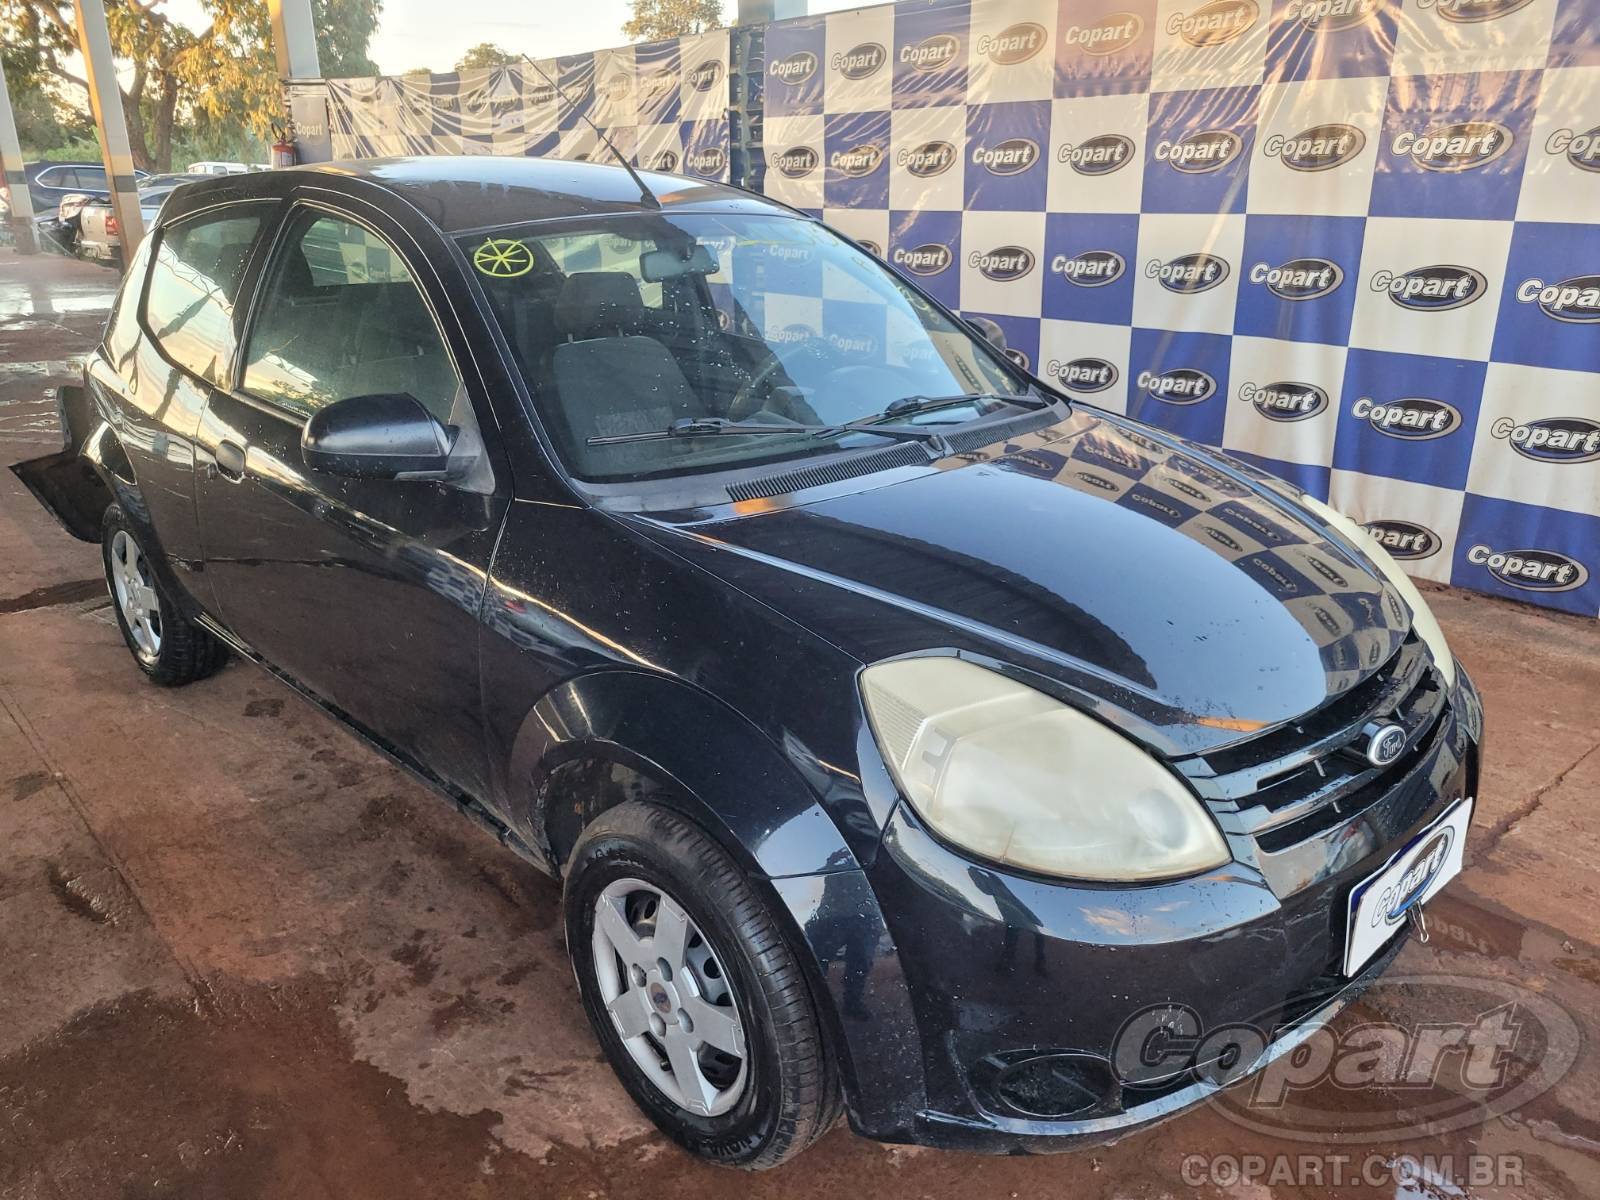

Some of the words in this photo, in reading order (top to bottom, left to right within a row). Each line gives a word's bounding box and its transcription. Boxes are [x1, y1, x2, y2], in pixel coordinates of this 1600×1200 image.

[1065, 17, 1134, 46] Copart
[1166, 8, 1245, 37] Copart
[900, 42, 957, 66] Copart
[977, 31, 1036, 58] Copart
[769, 58, 813, 78] Copart
[831, 49, 879, 71] Copart
[296, 122, 323, 137] Copart
[1058, 140, 1126, 170] Copart
[1154, 137, 1234, 163] Copart
[1264, 133, 1352, 162] Copart
[1391, 128, 1498, 159] Copart
[687, 151, 722, 168] Copart
[771, 153, 814, 172] Copart
[831, 148, 878, 170] Copart
[897, 146, 949, 171] Copart
[972, 144, 1032, 169] Copart
[894, 248, 945, 268] Copart
[968, 251, 1027, 273] Copart
[1052, 255, 1117, 278] Copart
[1144, 259, 1217, 285] Copart
[1249, 263, 1334, 290] Copart
[1370, 269, 1471, 299] Copart
[1047, 359, 1109, 384] Copart
[1137, 372, 1205, 397] Copart
[1239, 382, 1316, 412] Copart
[1351, 398, 1449, 431] Copart
[1491, 417, 1600, 453] Copart
[1467, 544, 1576, 583] Copart
[1383, 734, 1402, 758] Ford
[1371, 836, 1447, 928] Copart
